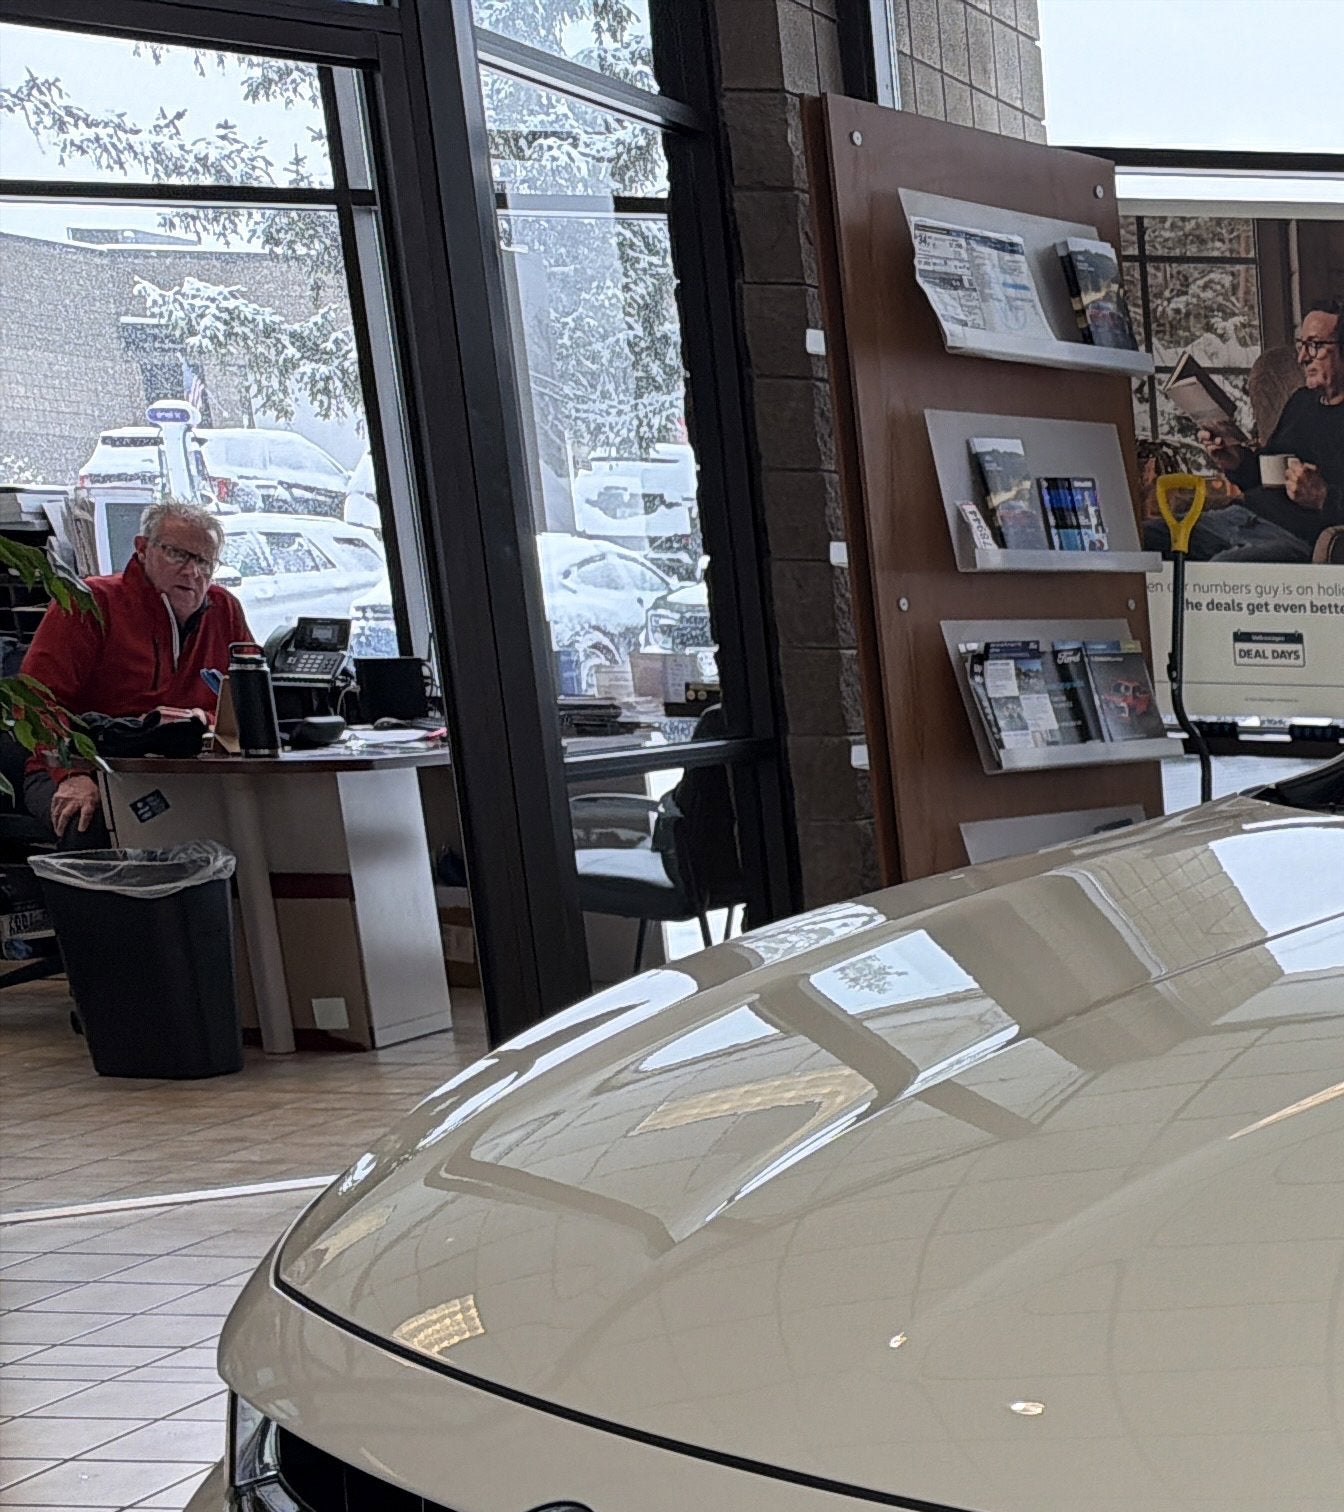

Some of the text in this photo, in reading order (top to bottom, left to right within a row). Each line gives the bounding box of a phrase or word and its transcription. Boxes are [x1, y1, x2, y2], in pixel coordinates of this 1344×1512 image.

[1193, 581, 1251, 595] numbers
[1255, 583, 1279, 598] guy
[1282, 583, 1293, 595] is
[1296, 585, 1314, 596] on
[1186, 599, 1203, 611] he
[1206, 599, 1243, 612] deals
[1246, 602, 1270, 616] get
[1273, 602, 1307, 613] even
[1238, 648, 1301, 661] DEAL DAYS
